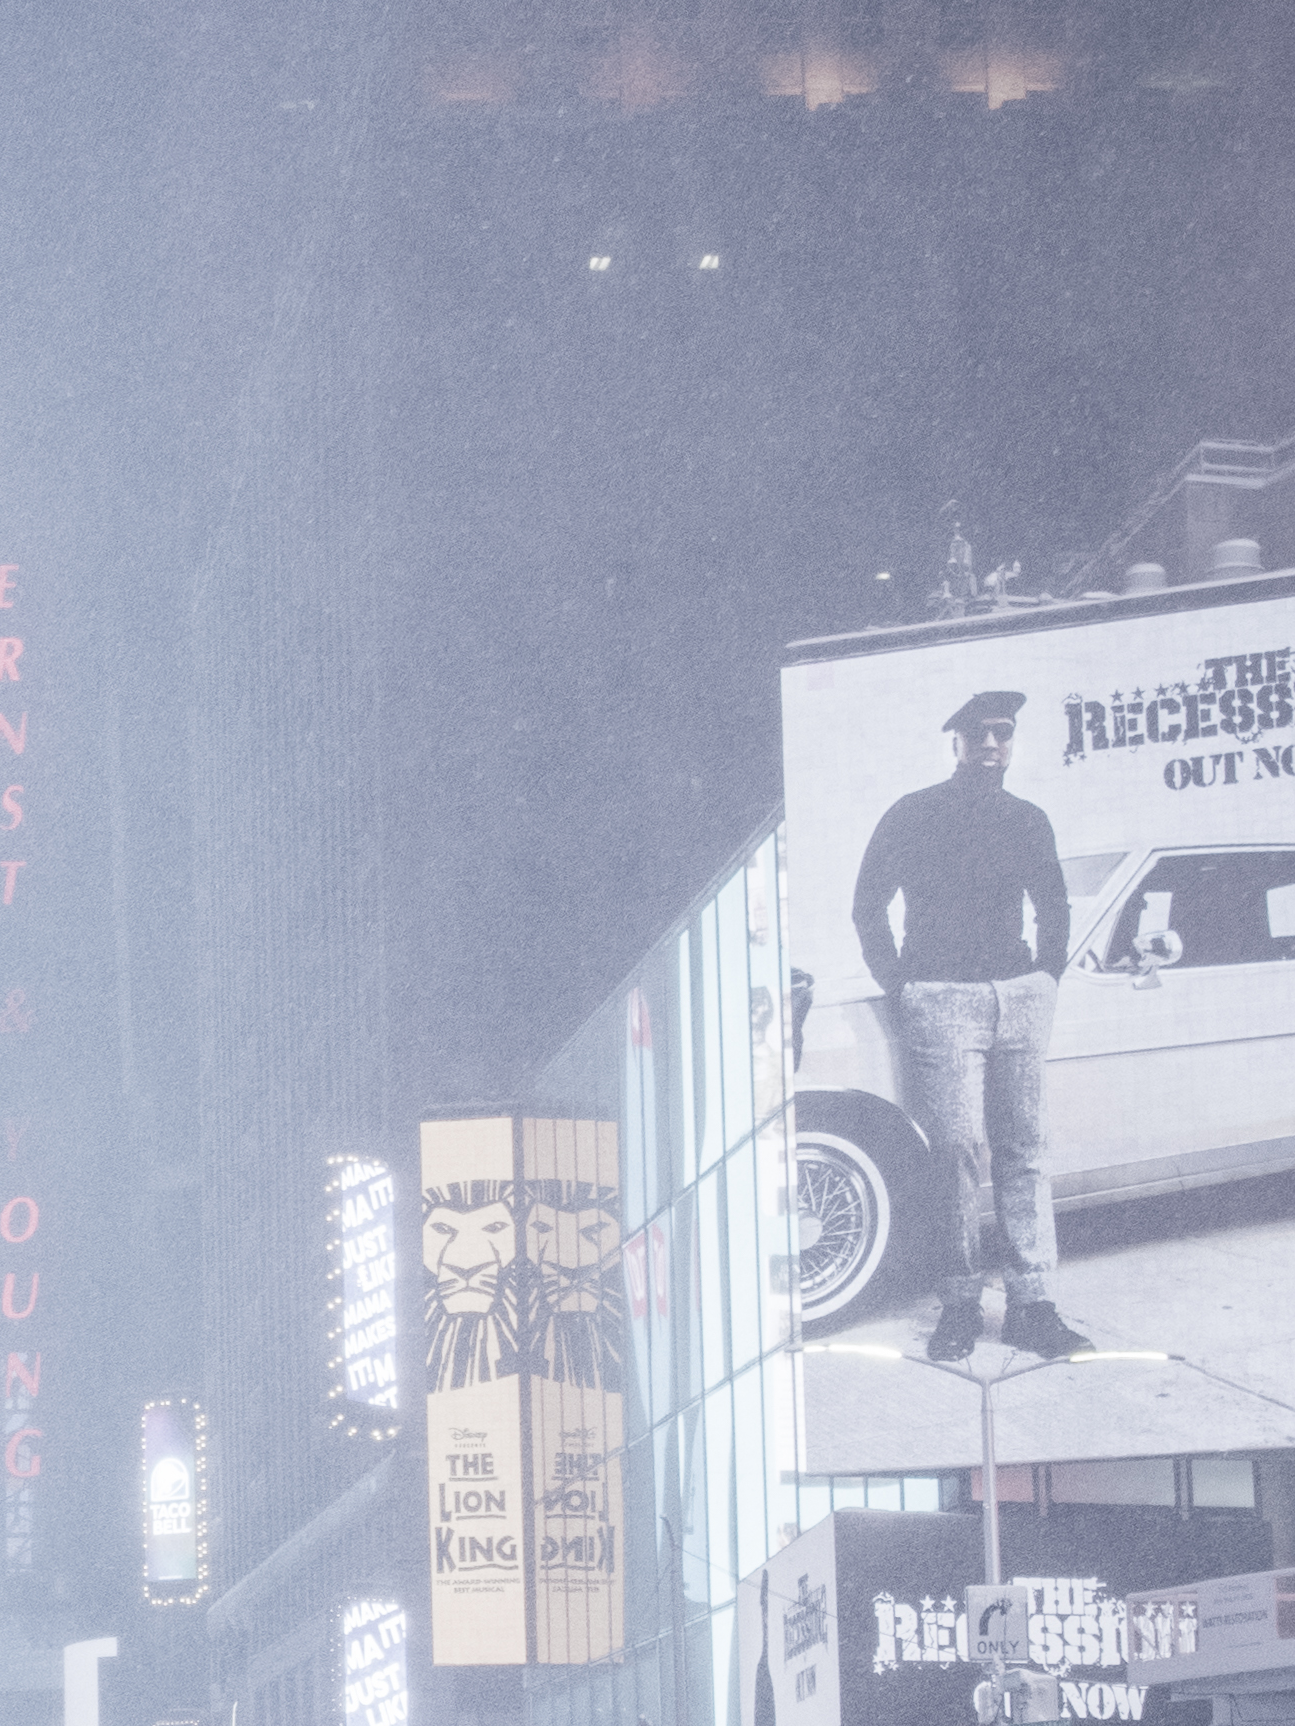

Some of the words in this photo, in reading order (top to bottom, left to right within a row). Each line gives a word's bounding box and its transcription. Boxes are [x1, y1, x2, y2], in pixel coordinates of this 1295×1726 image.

[1203, 647, 1293, 691] THE
[1163, 751, 1244, 791] OUT
[368, 1175, 394, 1210] IT!
[342, 1224, 387, 1270] JUST
[344, 1288, 392, 1330] MAMA
[344, 1315, 396, 1359] MAKES
[347, 1356, 375, 1391] IT!
[448, 1427, 488, 1443] Disney
[446, 1452, 494, 1476] THE
[149, 1502, 191, 1519] TACO
[438, 1482, 507, 1523] LION
[152, 1517, 192, 1536] BELL
[434, 1526, 517, 1574] KING
[1013, 1576, 1107, 1617] THE
[378, 1612, 407, 1649] IT!
[977, 1640, 1020, 1655] ONLY
[345, 1662, 400, 1714] JUST
[1059, 1682, 1150, 1720] NOW
